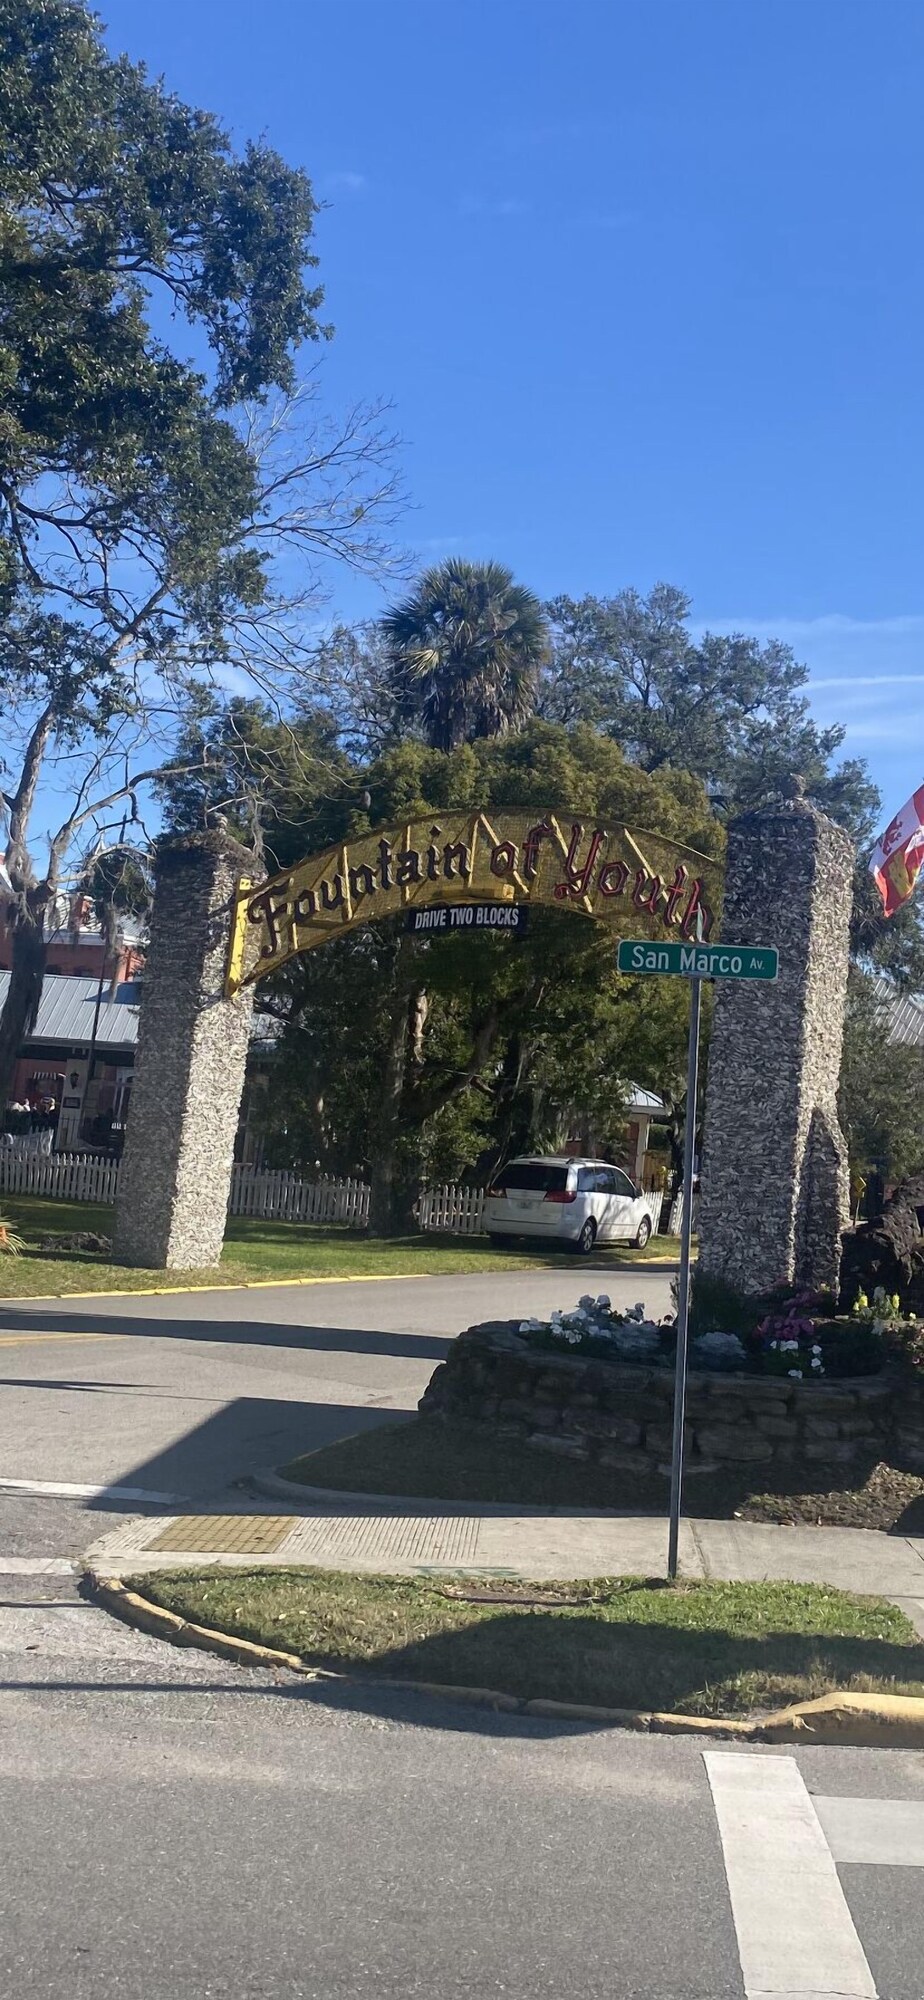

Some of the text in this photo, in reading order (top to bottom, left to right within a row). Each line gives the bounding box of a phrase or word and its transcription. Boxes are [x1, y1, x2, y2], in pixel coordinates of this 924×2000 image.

[248, 819, 714, 958] Fountain of Youth
[415, 907, 519, 929] DRIVE TWO BLOCKS
[631, 945, 669, 969] San
[680, 948, 742, 974] Marco
